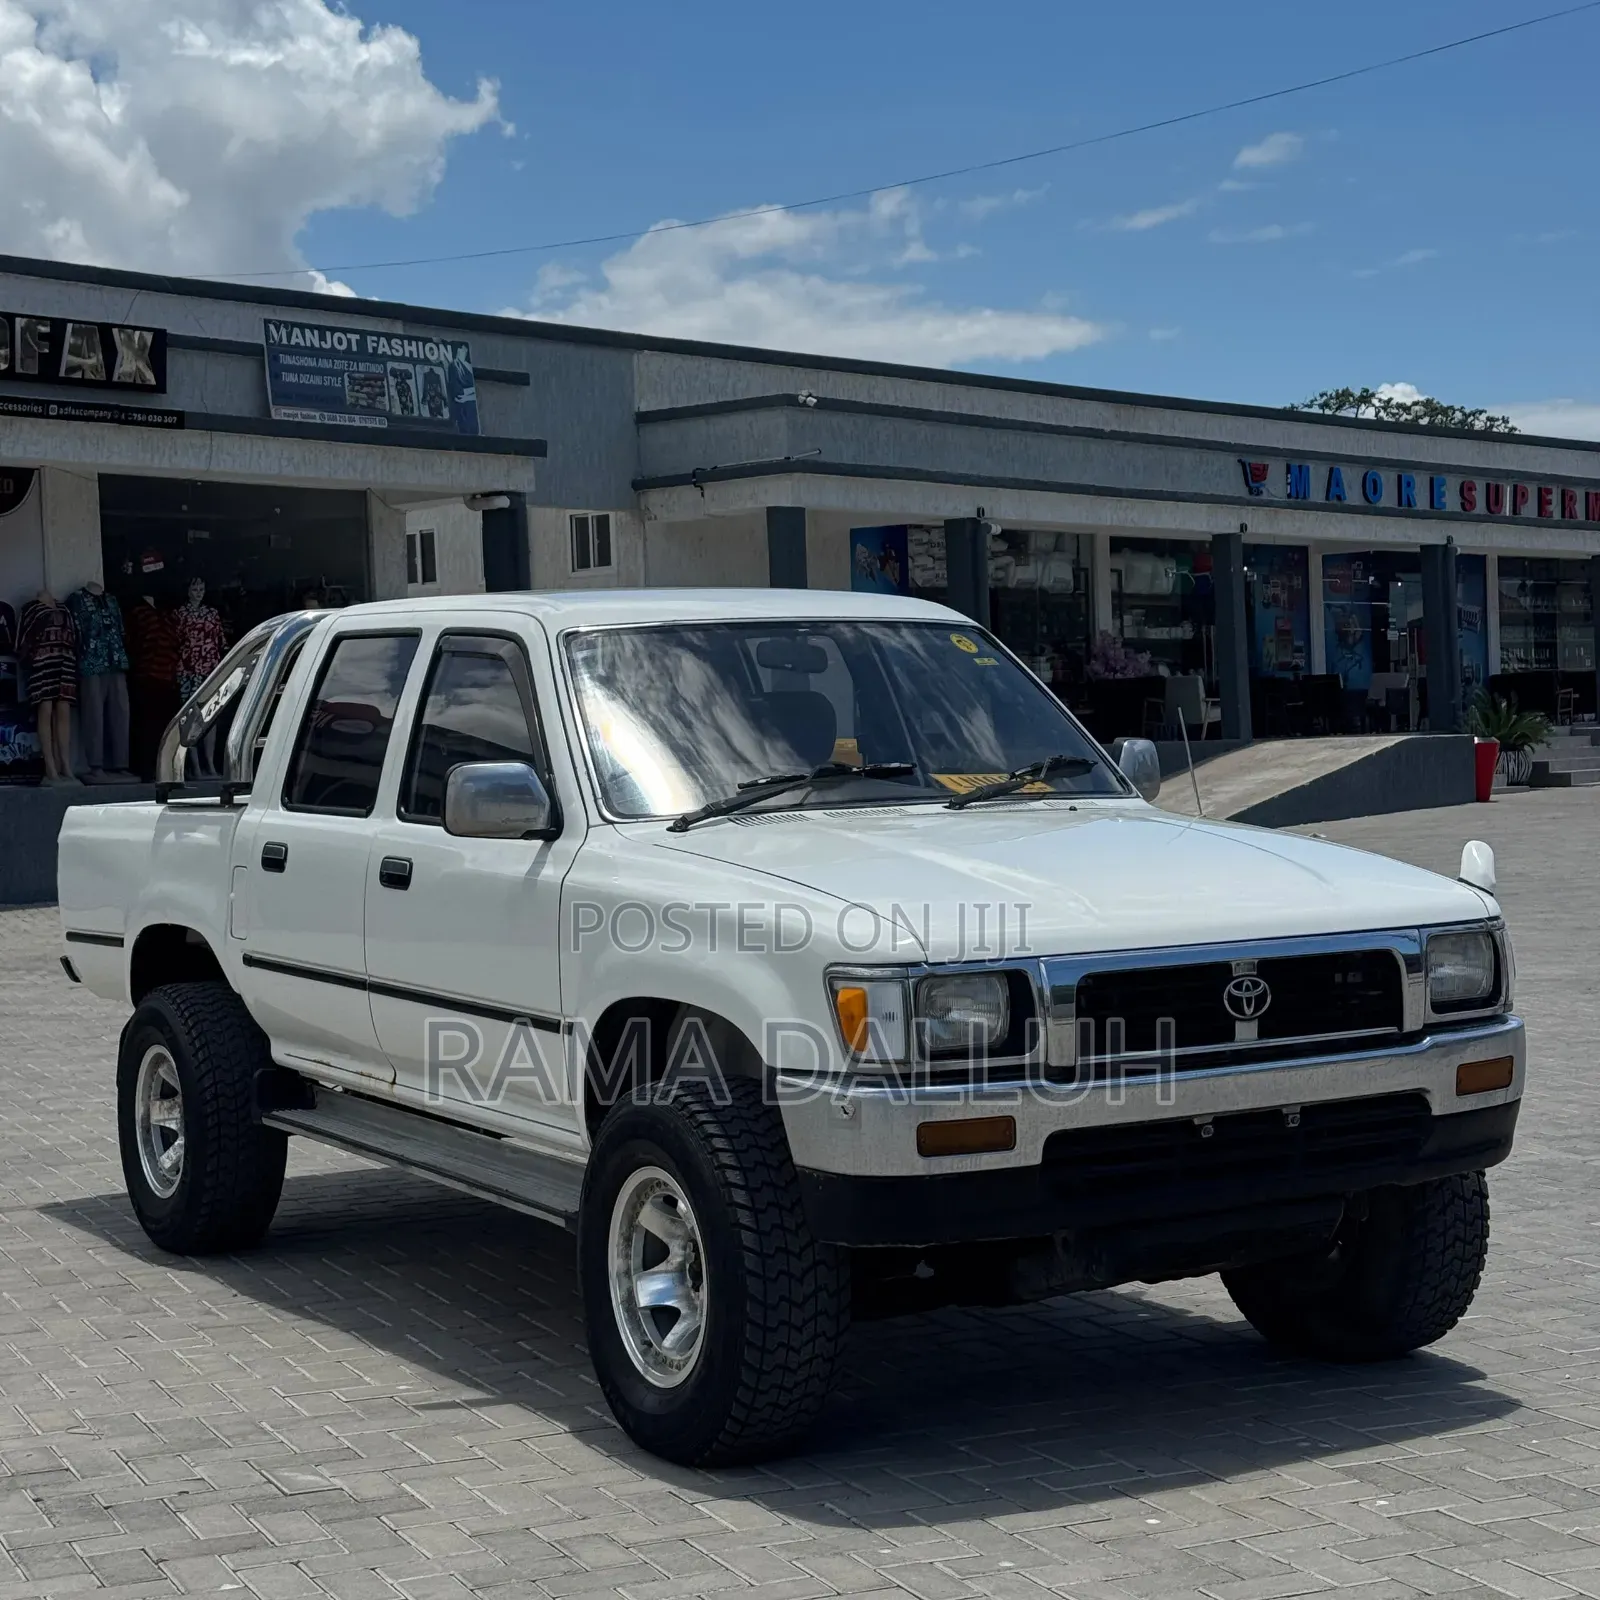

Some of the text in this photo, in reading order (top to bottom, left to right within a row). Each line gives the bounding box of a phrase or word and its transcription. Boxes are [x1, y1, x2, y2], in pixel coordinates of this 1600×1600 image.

[0, 316, 157, 385] FAX
[268, 321, 453, 363] MANJOT FASHION
[279, 354, 317, 368] TUNASHONA
[349, 361, 358, 371] ZA
[281, 372, 299, 383] TUNA
[323, 376, 342, 388] STYLE
[1286, 463, 1447, 511] MAORE
